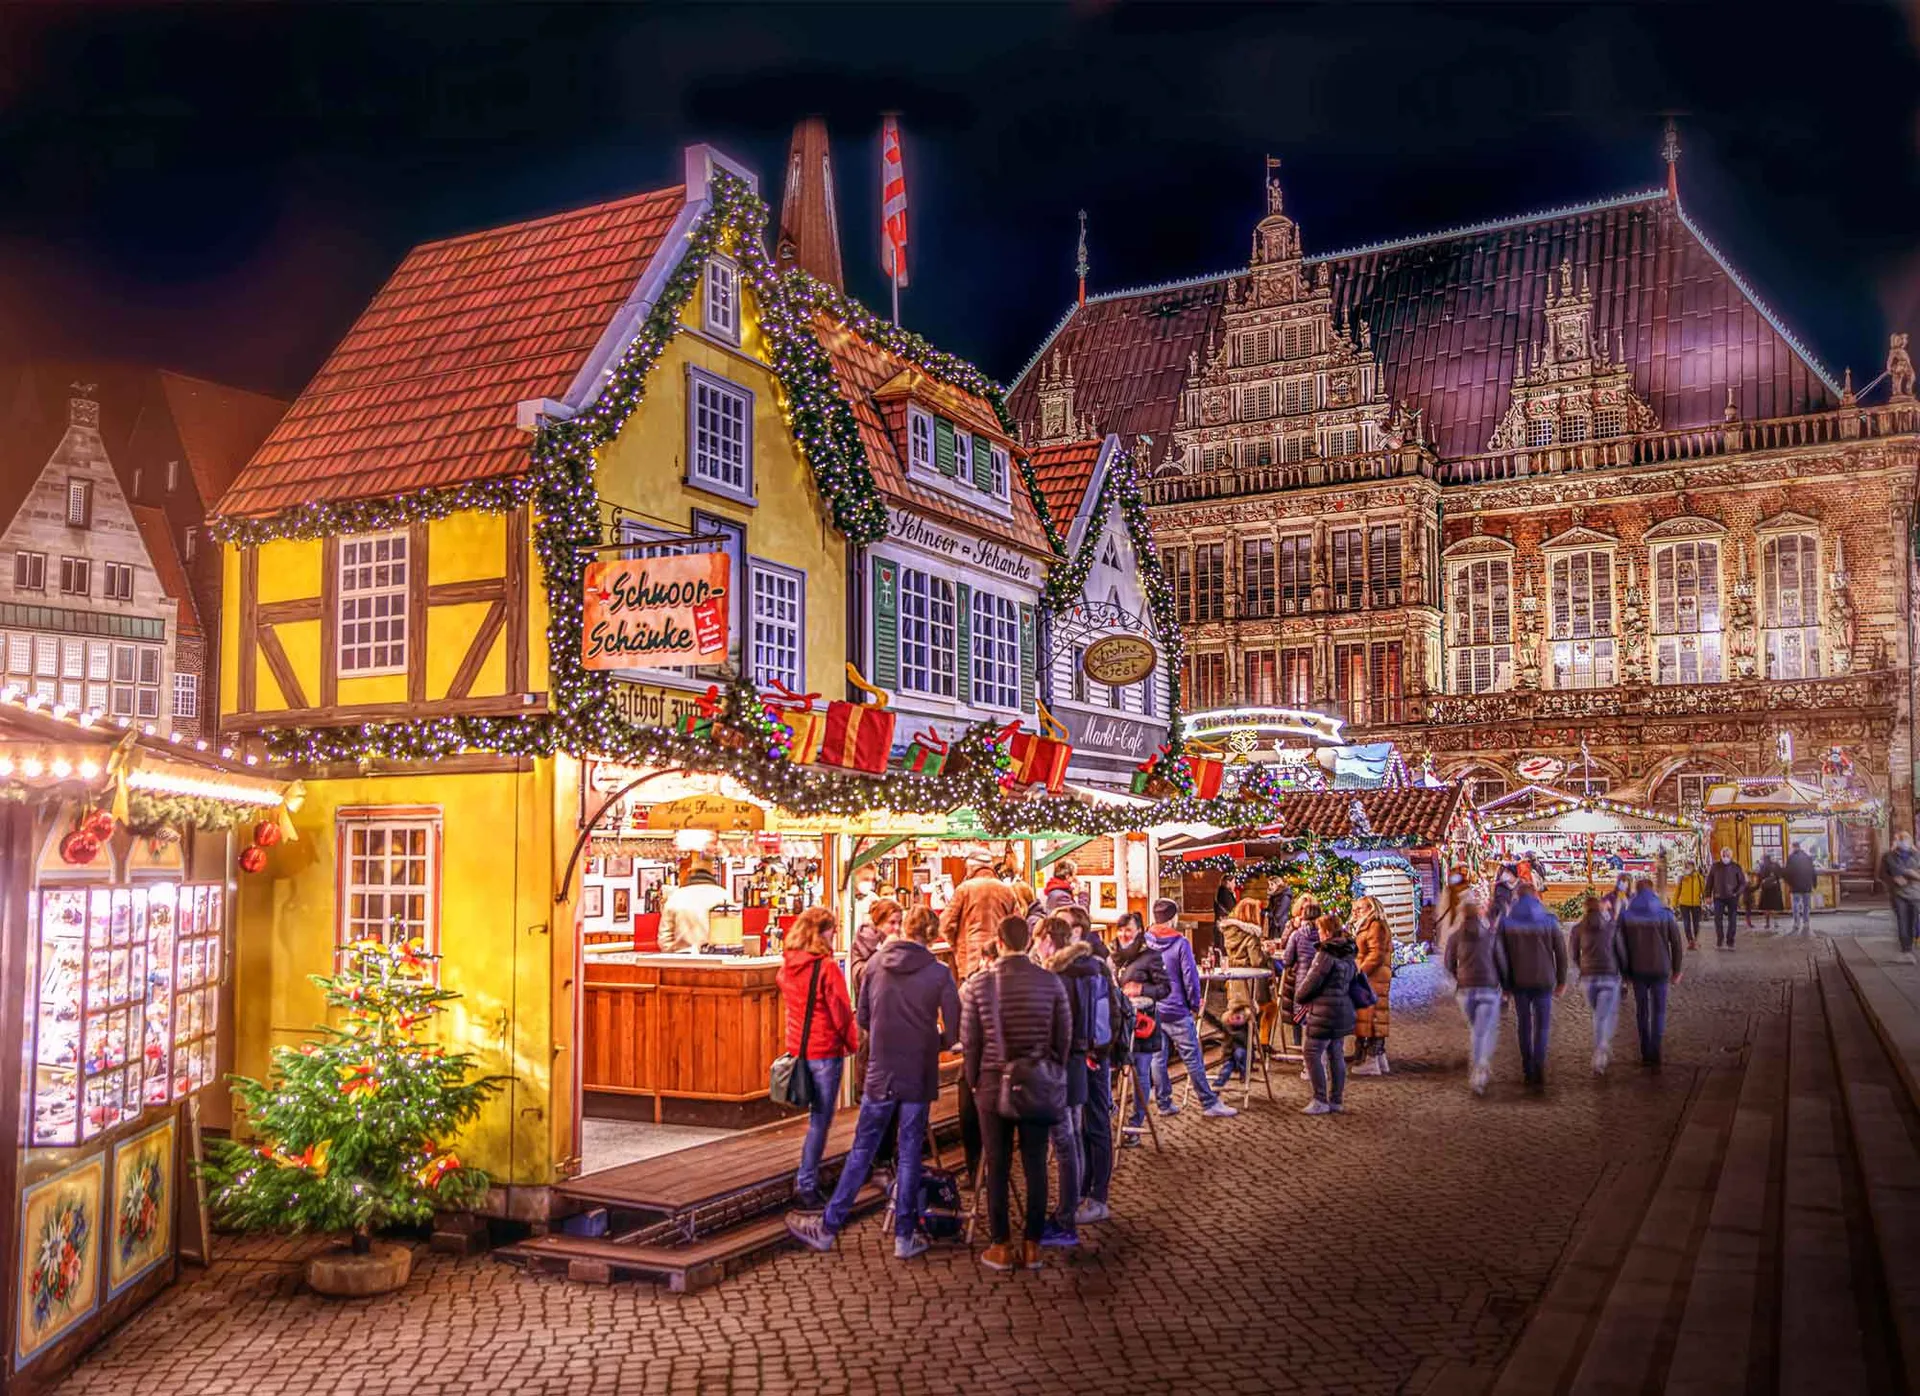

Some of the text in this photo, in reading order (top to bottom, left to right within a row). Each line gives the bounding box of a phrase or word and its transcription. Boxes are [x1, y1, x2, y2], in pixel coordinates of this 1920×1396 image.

[890, 506, 959, 554] Schnoor
[587, 617, 693, 656] Schänke
[1079, 714, 1145, 757] Markt-Café
